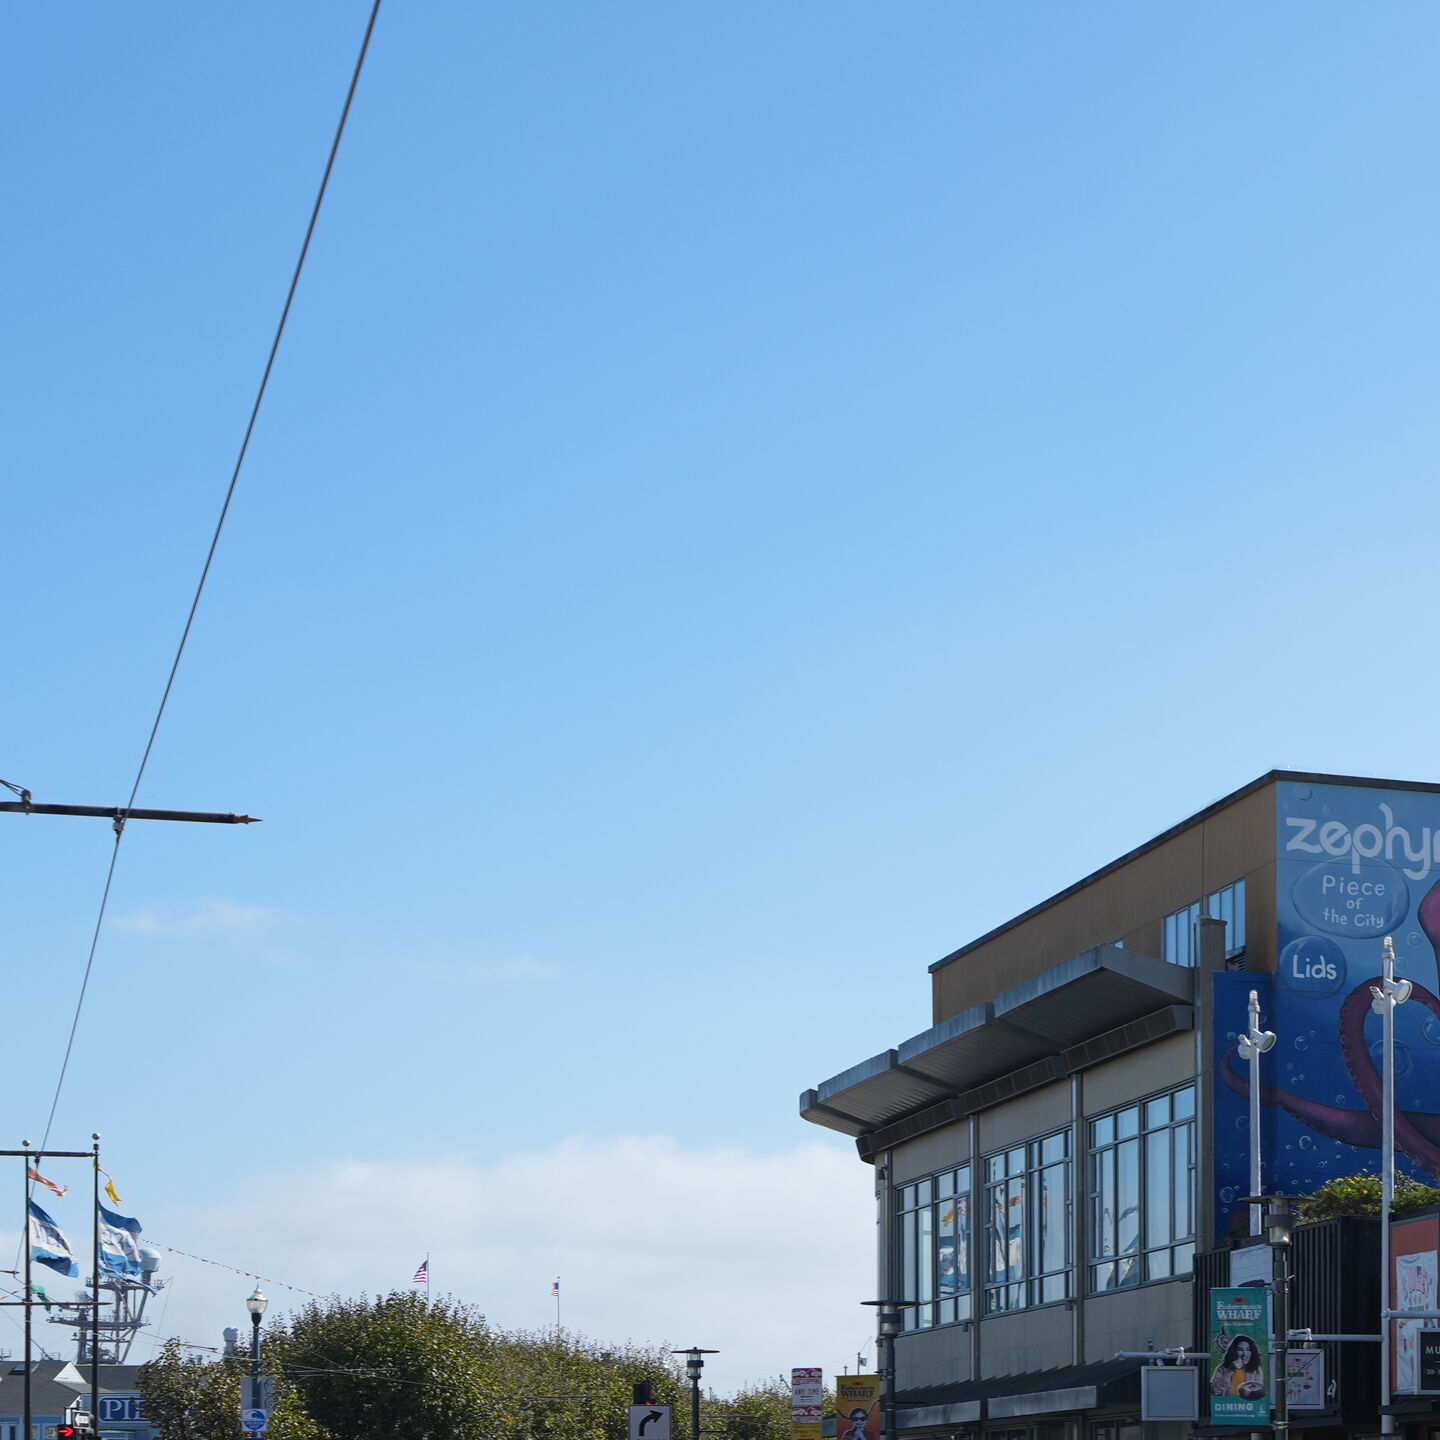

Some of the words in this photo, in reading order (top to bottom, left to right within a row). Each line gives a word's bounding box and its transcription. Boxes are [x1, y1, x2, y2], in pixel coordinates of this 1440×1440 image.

[1322, 875, 1385, 896] Piece
[1346, 897, 1364, 910] of
[1322, 907, 1347, 925] the
[1354, 913, 1384, 929] City
[1292, 954, 1337, 980] Lids
[1216, 1309, 1262, 1320] WHARF
[1215, 1403, 1254, 1411] DINING
